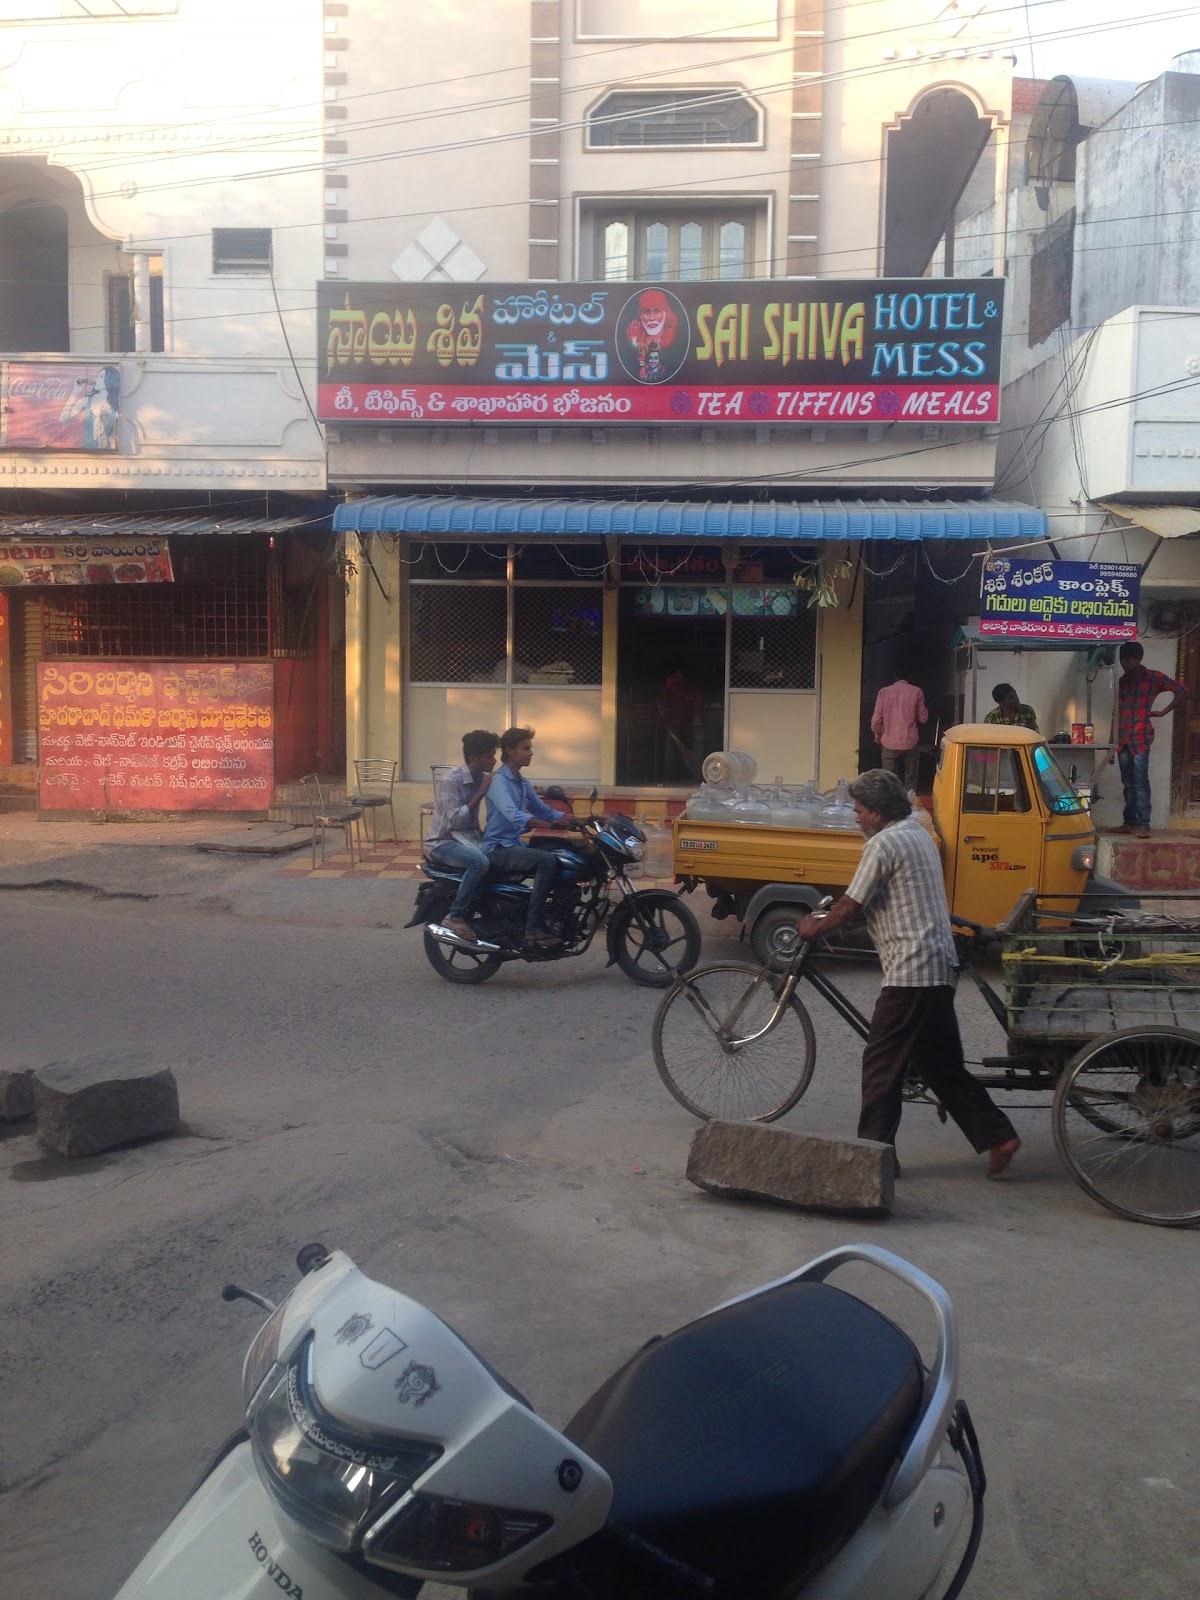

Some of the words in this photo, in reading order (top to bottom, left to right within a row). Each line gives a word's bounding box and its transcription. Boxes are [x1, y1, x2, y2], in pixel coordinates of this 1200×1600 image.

[492, 289, 608, 325] హోటల్
[874, 292, 984, 331] HOTEL
[984, 300, 998, 319] &
[327, 290, 417, 377] సాయి
[427, 294, 485, 368] శివ
[547, 331, 557, 343] &
[696, 303, 750, 368] SAI
[763, 302, 865, 368] SHIVA
[494, 339, 609, 382] మెస్
[871, 341, 987, 377] MESS
[365, 389, 423, 418] టిఫిన్స్
[427, 392, 446, 412] &
[451, 391, 548, 415] శాఖాహార
[553, 388, 631, 416] భోజనం
[697, 391, 744, 416] TEA
[776, 391, 875, 416] TIFFINS
[902, 391, 992, 416] MEALS
[91, 540, 160, 557] పాయింట్
[984, 573, 1006, 592] శివ
[1011, 562, 1053, 588] శంకర్
[1058, 579, 1129, 598] కాంప్లెక్స్
[986, 594, 1026, 612] గదులు
[1029, 595, 1068, 621] అద్దెకు
[1071, 599, 1134, 618] లభించును
[42, 668, 93, 701] సిరి
[96, 671, 154, 702] బిర్యాని
[971, 854, 999, 863] ape
[247, 1530, 304, 1600] HONDA
